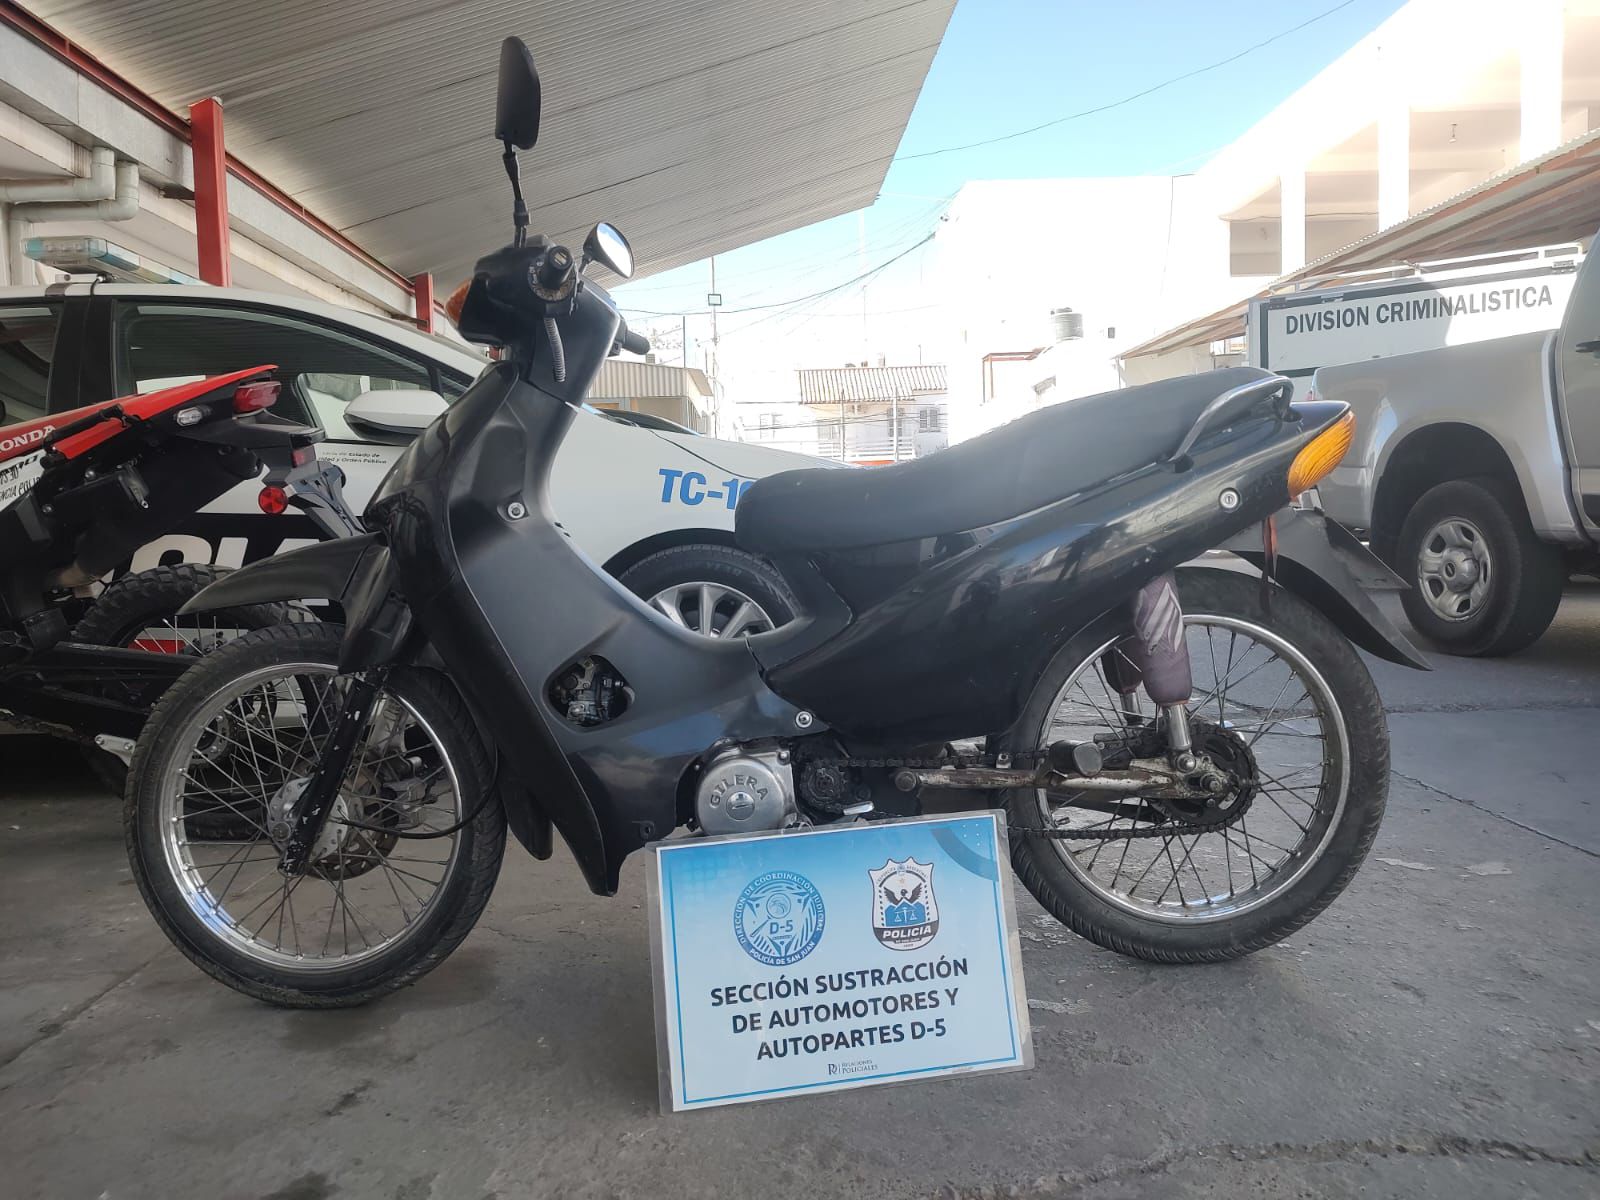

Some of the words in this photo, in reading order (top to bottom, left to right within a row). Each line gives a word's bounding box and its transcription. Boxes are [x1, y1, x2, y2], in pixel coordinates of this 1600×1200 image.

[1286, 305, 1369, 335] DIVISION
[1376, 285, 1552, 324] CRIMINALISTICA
[0, 425, 56, 453] ONDA
[659, 468, 755, 510] TC-1
[709, 774, 768, 808] GILERA
[769, 920, 794, 934] D-5
[710, 975, 809, 1006] SECCIÓN
[815, 955, 968, 994] SUSTRACCIÓN
[732, 1013, 763, 1034] DE
[769, 990, 940, 1029] AUTOMOTORES
[944, 988, 959, 1006] Y
[757, 1023, 905, 1060] AUTOPARTES
[910, 1018, 947, 1040] D-5
